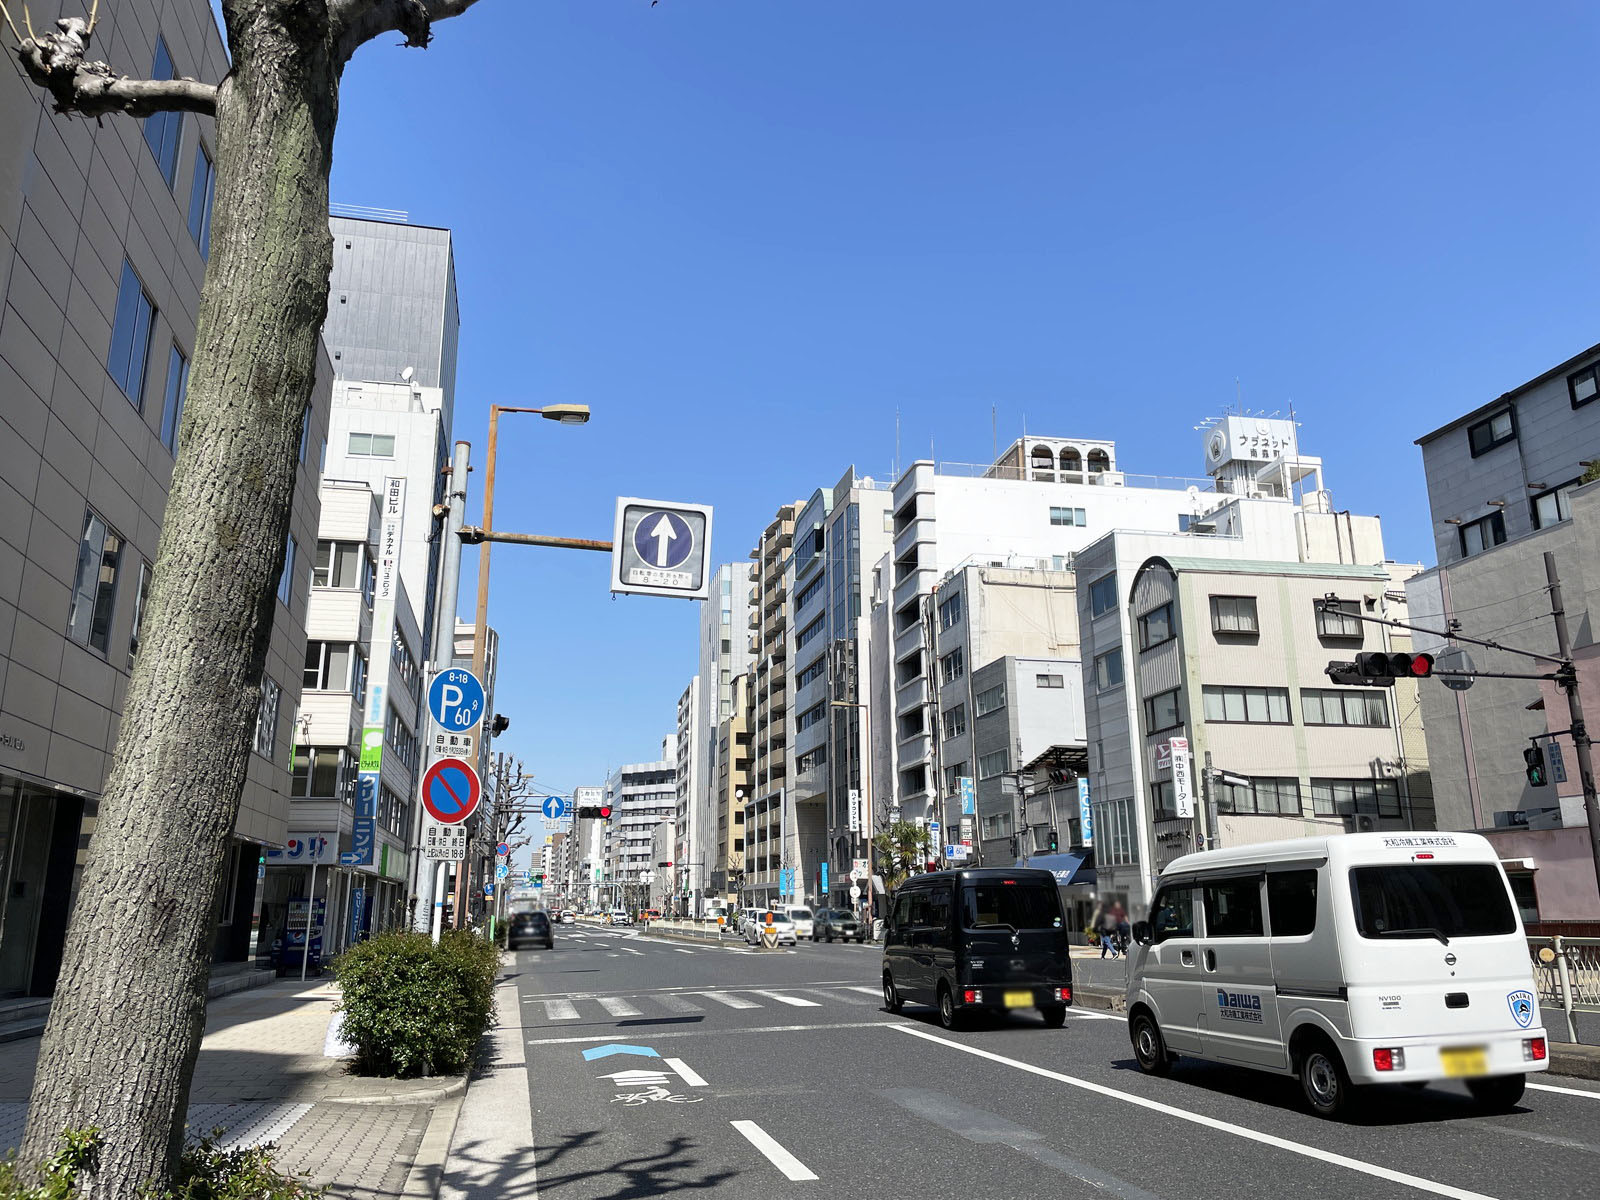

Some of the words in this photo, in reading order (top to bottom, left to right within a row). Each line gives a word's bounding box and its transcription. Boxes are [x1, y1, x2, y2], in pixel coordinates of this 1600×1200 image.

[1239, 434, 1289, 448] プラネット
[1250, 448, 1280, 459] 南森町
[388, 479, 400, 514] 和田ビル
[449, 672, 468, 684] 8-18
[440, 684, 463, 723] P
[454, 708, 471, 726] 60
[436, 734, 471, 747] 自動車
[429, 827, 466, 837] 自動車
[1217, 988, 1262, 1010] Daiwa
[1511, 993, 1531, 1002] DAIWA
